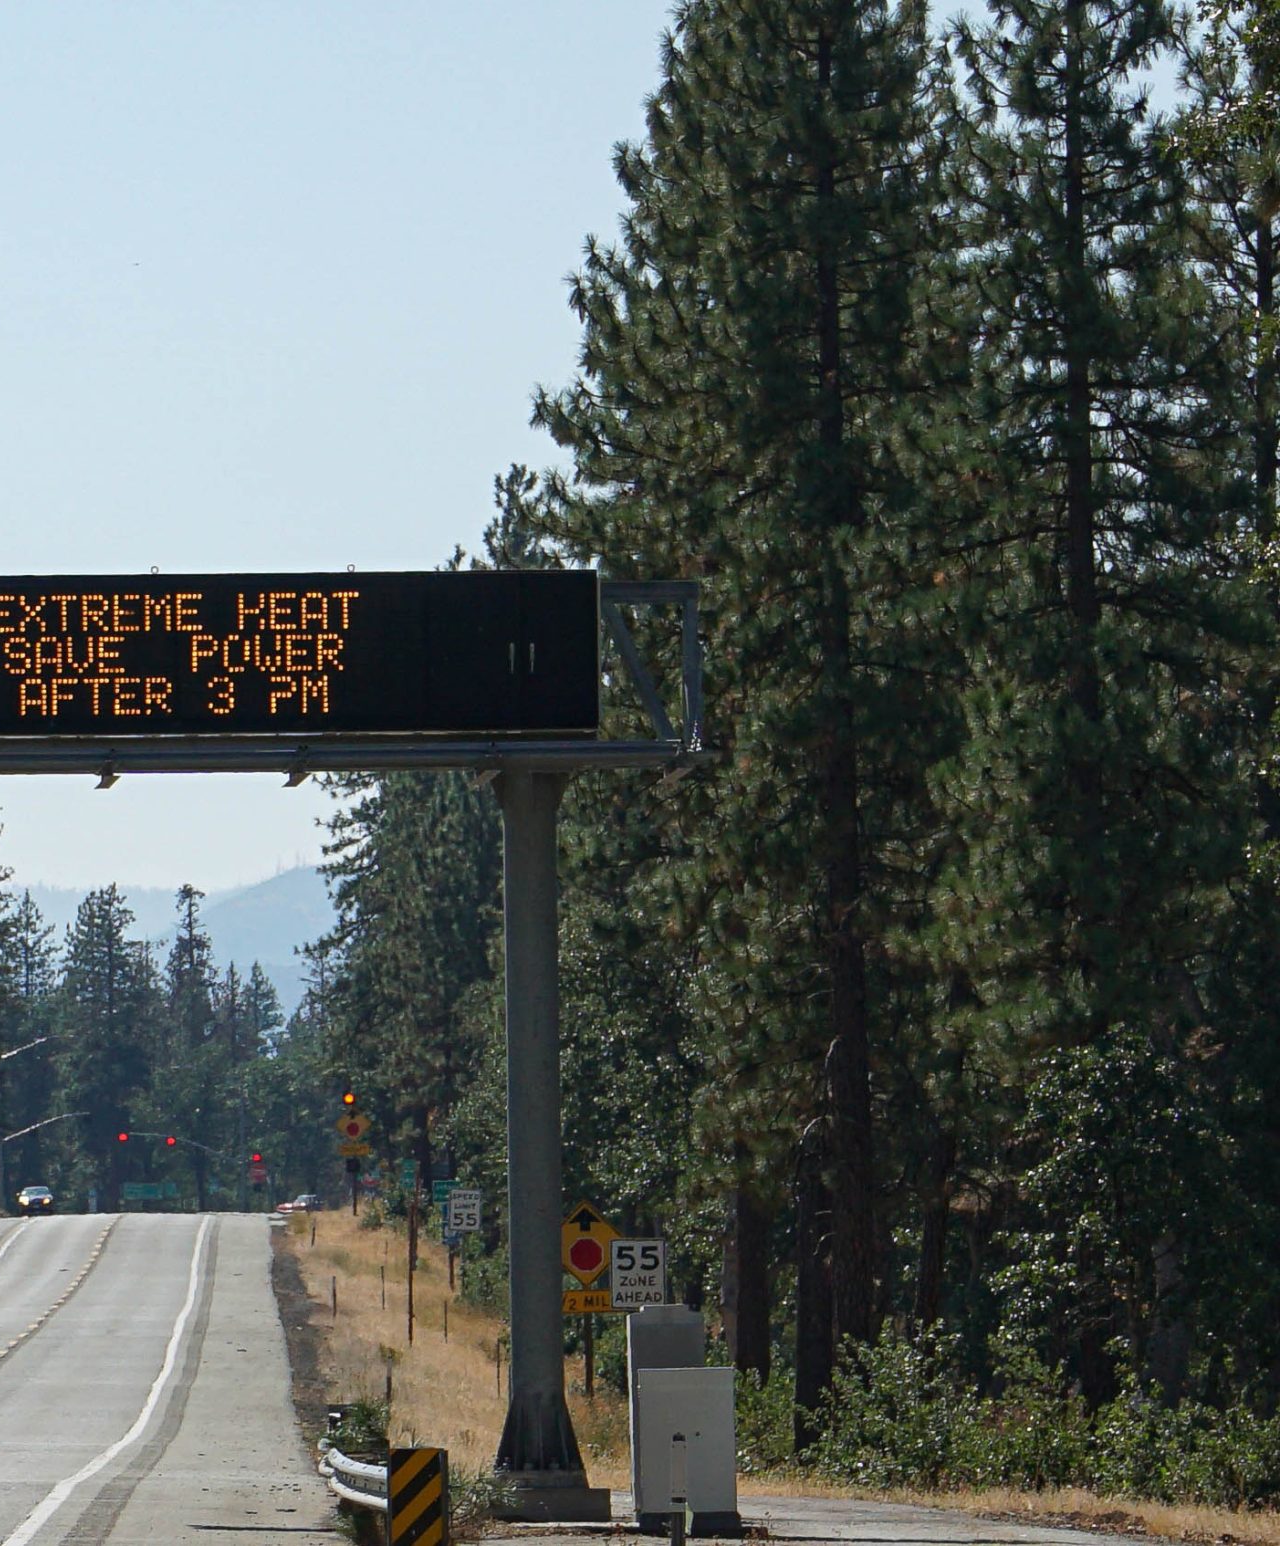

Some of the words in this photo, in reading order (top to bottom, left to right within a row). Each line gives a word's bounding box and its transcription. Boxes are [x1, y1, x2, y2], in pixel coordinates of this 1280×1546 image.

[238, 591, 358, 630] HEAT
[4, 636, 124, 674] SAVE
[191, 633, 343, 673] POWER
[20, 677, 172, 715] AFTER
[208, 676, 235, 714] 3
[270, 675, 329, 713] PM
[453, 1213, 477, 1226] 55
[617, 1246, 660, 1271] 55
[619, 1275, 657, 1287] ZONE
[562, 1293, 577, 1310] /2
[584, 1295, 609, 1308] MIL
[615, 1291, 663, 1303] AHEAD
